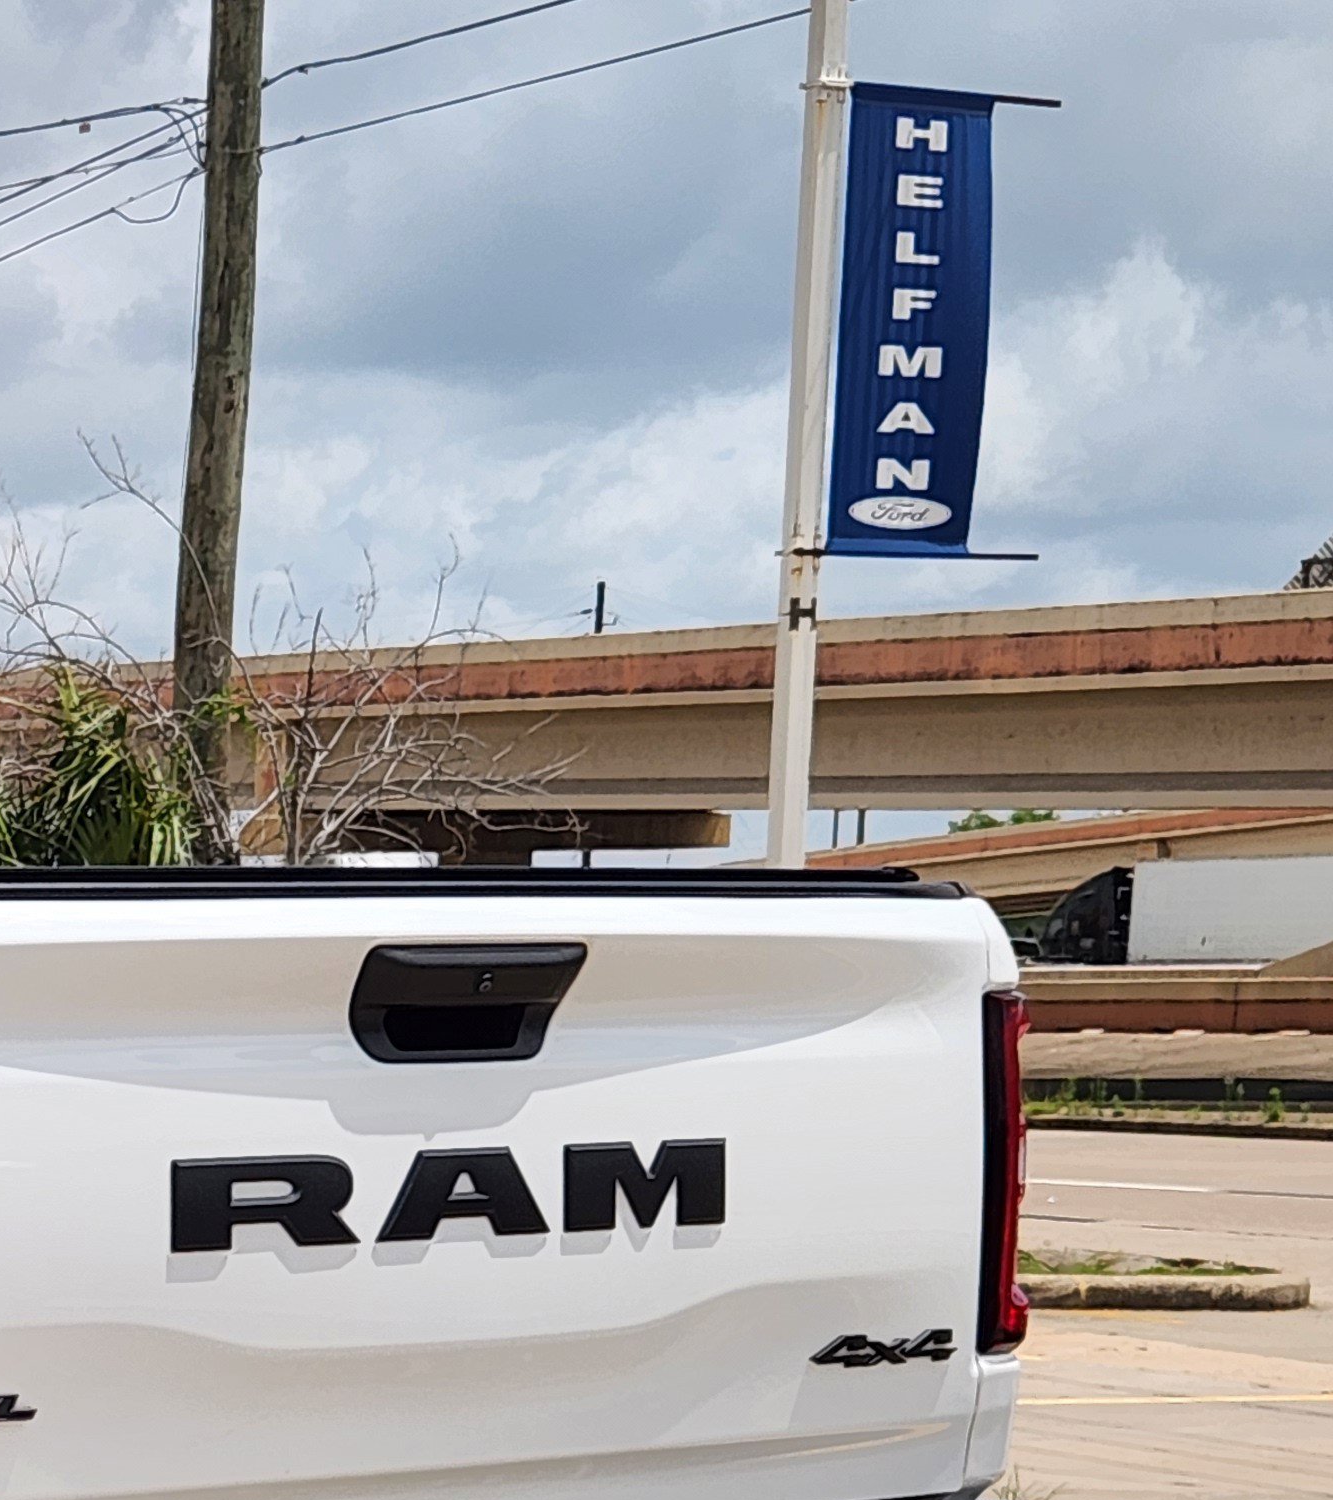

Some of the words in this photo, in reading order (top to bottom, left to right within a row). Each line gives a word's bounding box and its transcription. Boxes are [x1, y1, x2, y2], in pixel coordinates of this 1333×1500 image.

[875, 116, 949, 492] HELFMAN
[870, 501, 931, 522] Ford
[170, 1136, 728, 1254] RAM
[808, 1328, 958, 1369] 4x4
